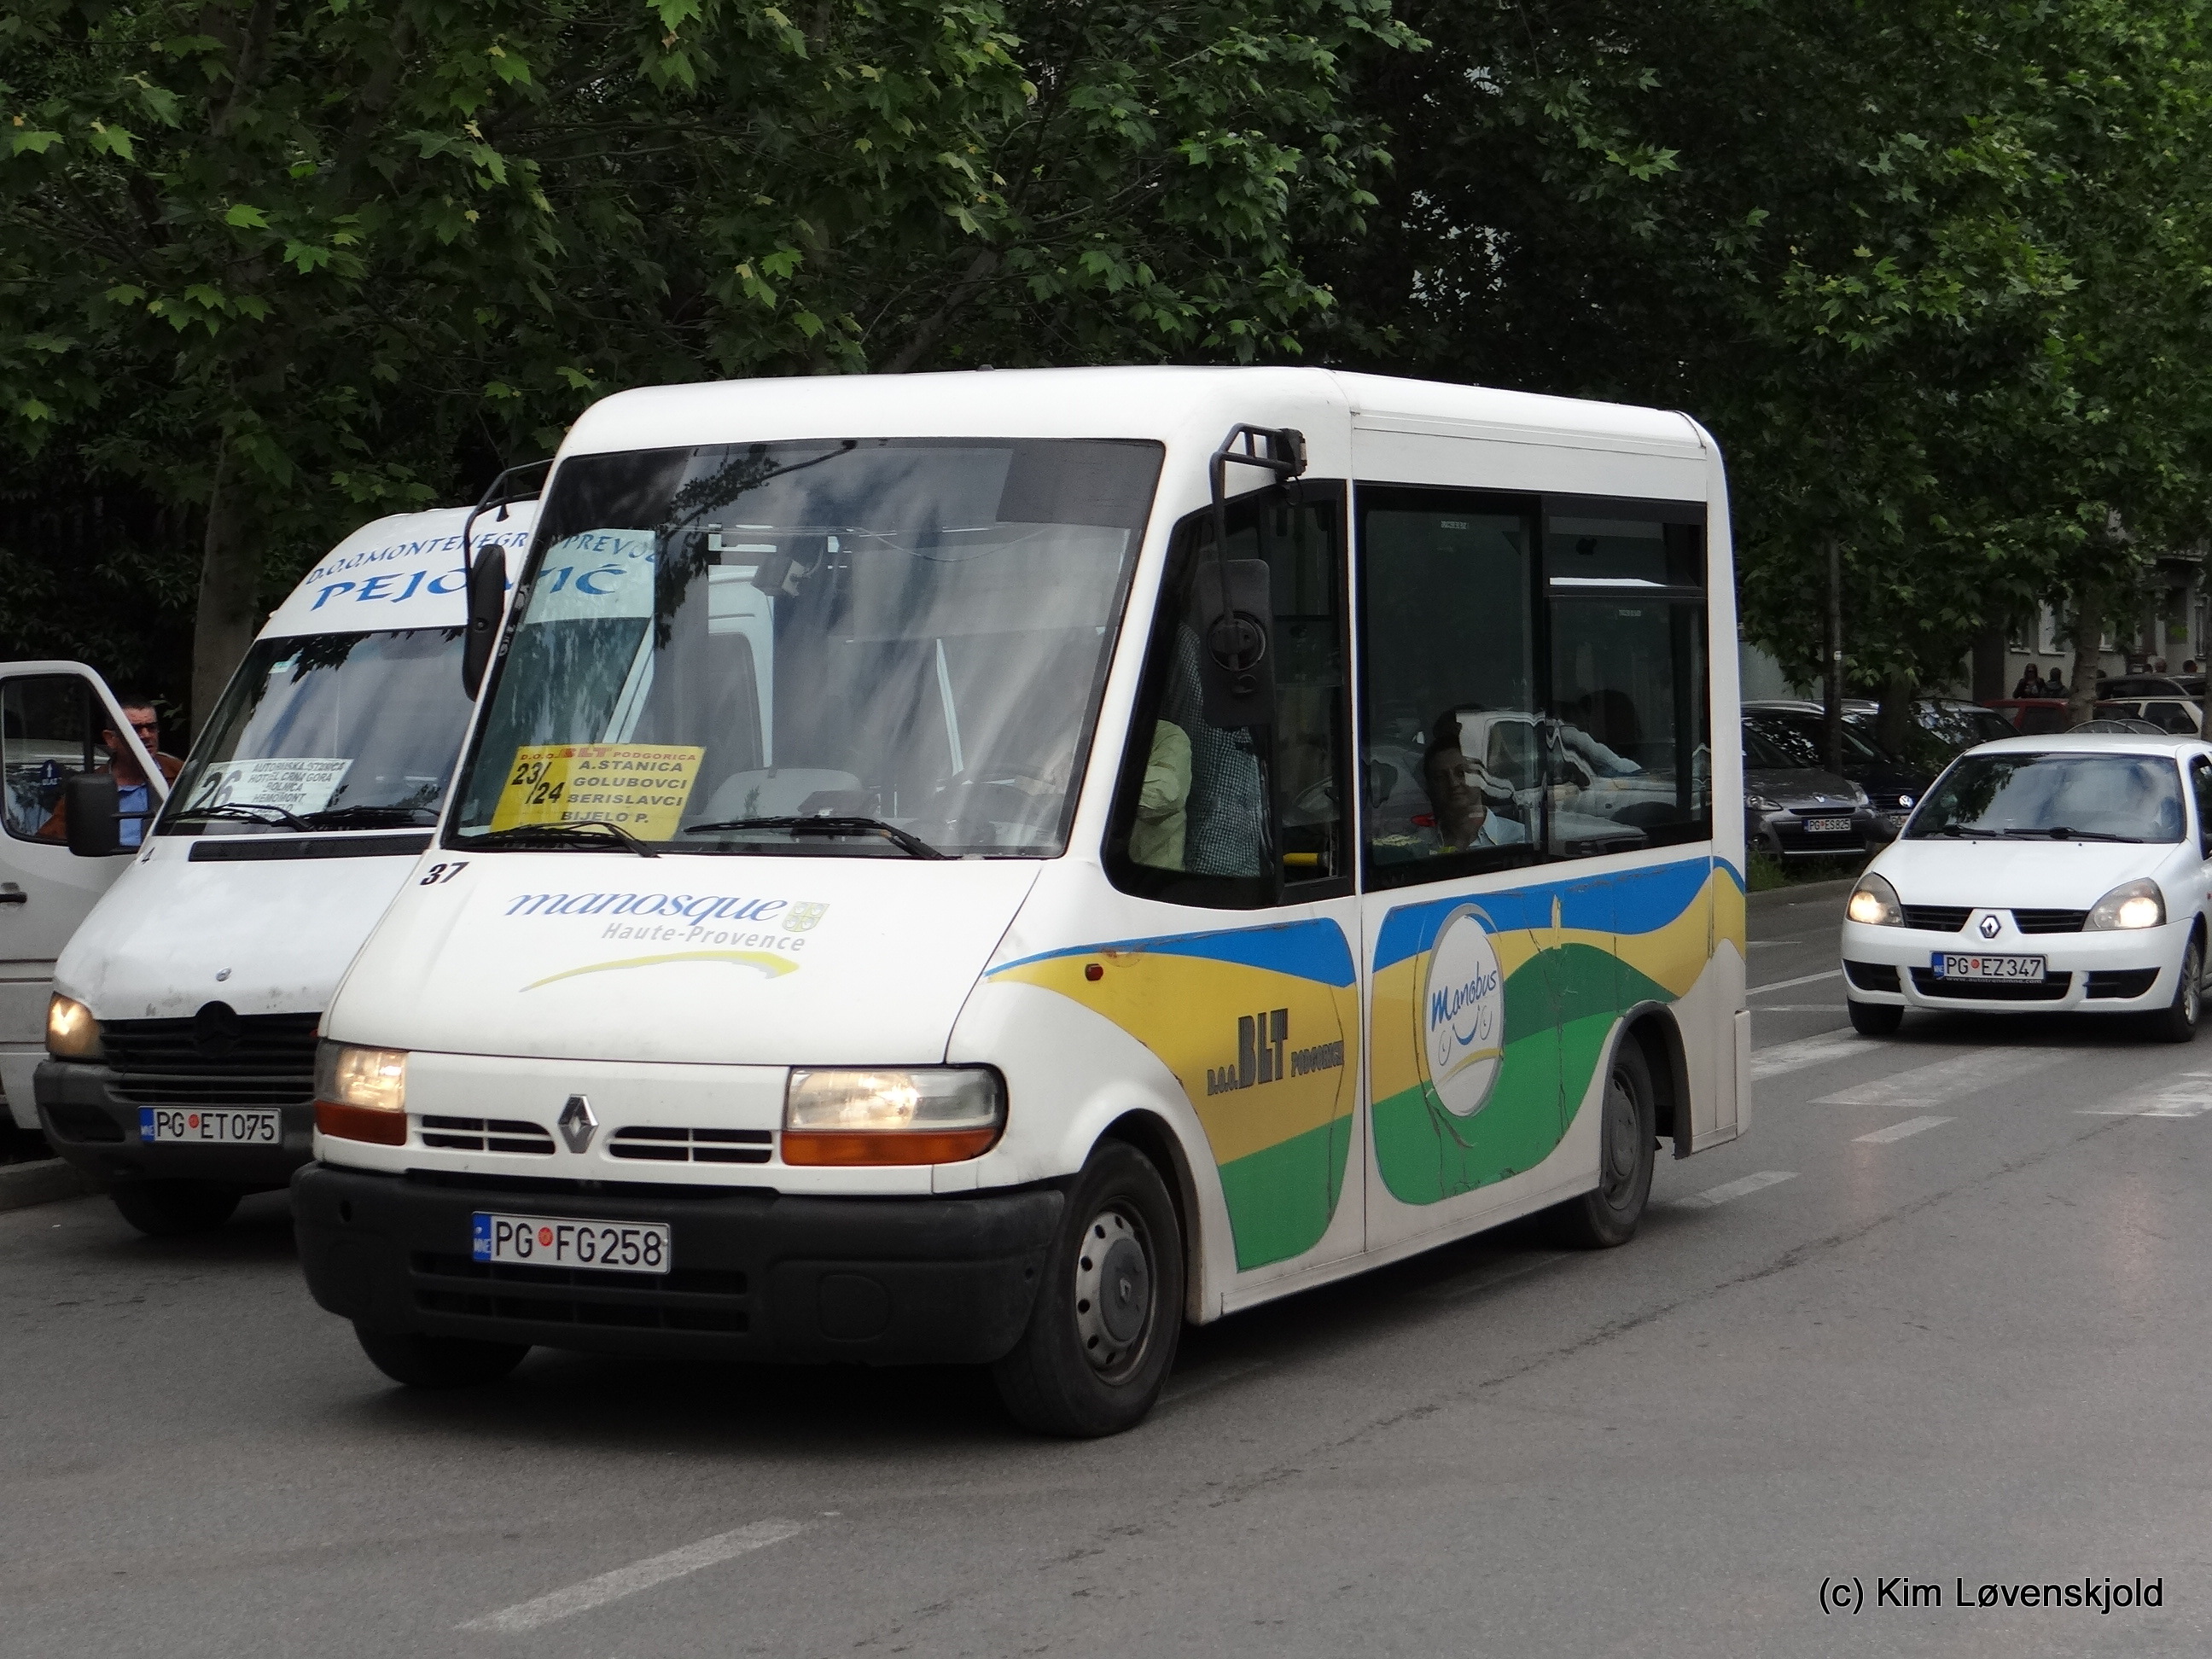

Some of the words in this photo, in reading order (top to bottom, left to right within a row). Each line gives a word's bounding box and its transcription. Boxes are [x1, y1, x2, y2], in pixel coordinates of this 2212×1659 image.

[614, 751, 696, 761] PODGORICA
[579, 760, 683, 772] A.STANICA
[247, 771, 277, 783] HOTEL
[280, 771, 306, 782] CRNA
[306, 772, 333, 783] GORA
[573, 776, 687, 789] GOLUBOVCI
[188, 769, 242, 811] 26
[567, 793, 684, 806] BERISLAVCI
[560, 811, 628, 823] BIJELO
[635, 812, 649, 824] P.
[1809, 820, 1820, 830] PG
[419, 861, 470, 886] 37
[504, 892, 789, 926] manosque
[601, 922, 806, 952] Haute-Provence
[1947, 957, 1969, 975] PG
[1981, 958, 2041, 977] EZ347
[156, 1111, 185, 1138] PG
[201, 1112, 275, 1141] ET075
[495, 1220, 533, 1259] PG
[556, 1225, 662, 1266] FG258
